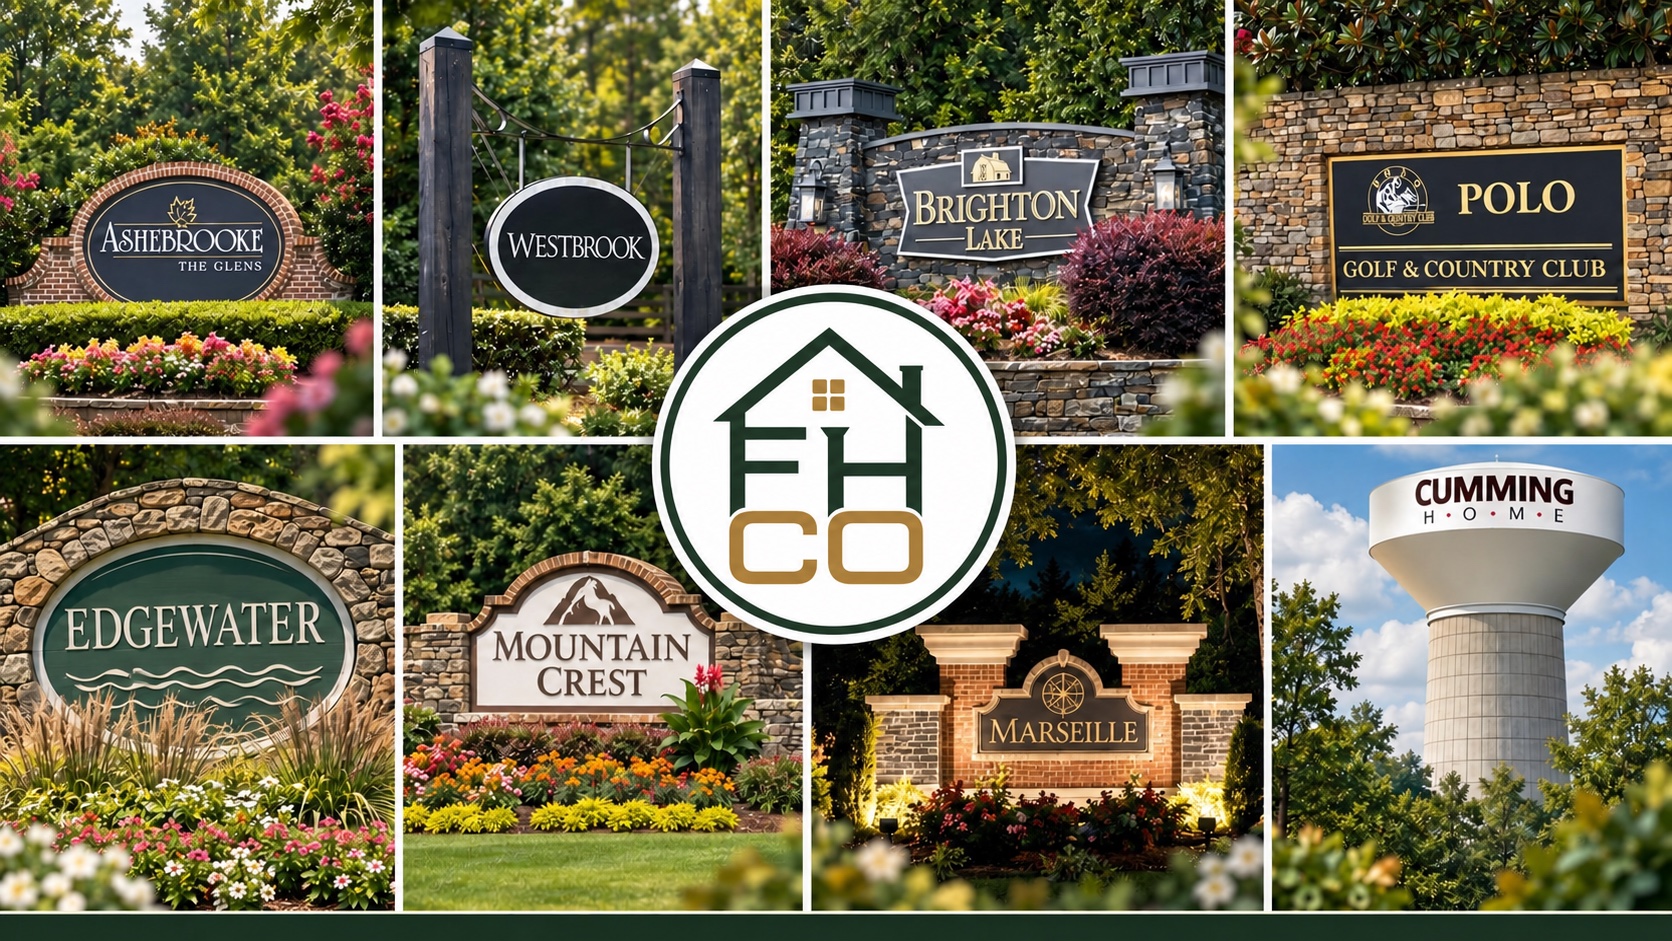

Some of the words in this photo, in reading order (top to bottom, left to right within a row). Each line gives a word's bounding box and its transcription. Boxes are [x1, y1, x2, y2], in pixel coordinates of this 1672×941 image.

[913, 189, 1081, 225] BRIGHTON
[1457, 179, 1576, 215] POLO
[100, 221, 263, 254] ASHEBROOKE
[506, 232, 646, 260] WESTBROOK
[965, 226, 1024, 251] LAKE
[178, 261, 207, 272] THE
[213, 261, 262, 272] GLENS
[1342, 260, 1397, 278] GOLF
[1402, 260, 1420, 278] &
[1424, 259, 1536, 278] COUNTRY
[1542, 259, 1607, 278] CLUB
[1415, 475, 1574, 506] CUMMING
[64, 601, 325, 651] EDGEWATER
[492, 630, 692, 662] MOUNTAIN
[537, 666, 648, 697] CREST
[988, 717, 1139, 744] MARSEILLE
